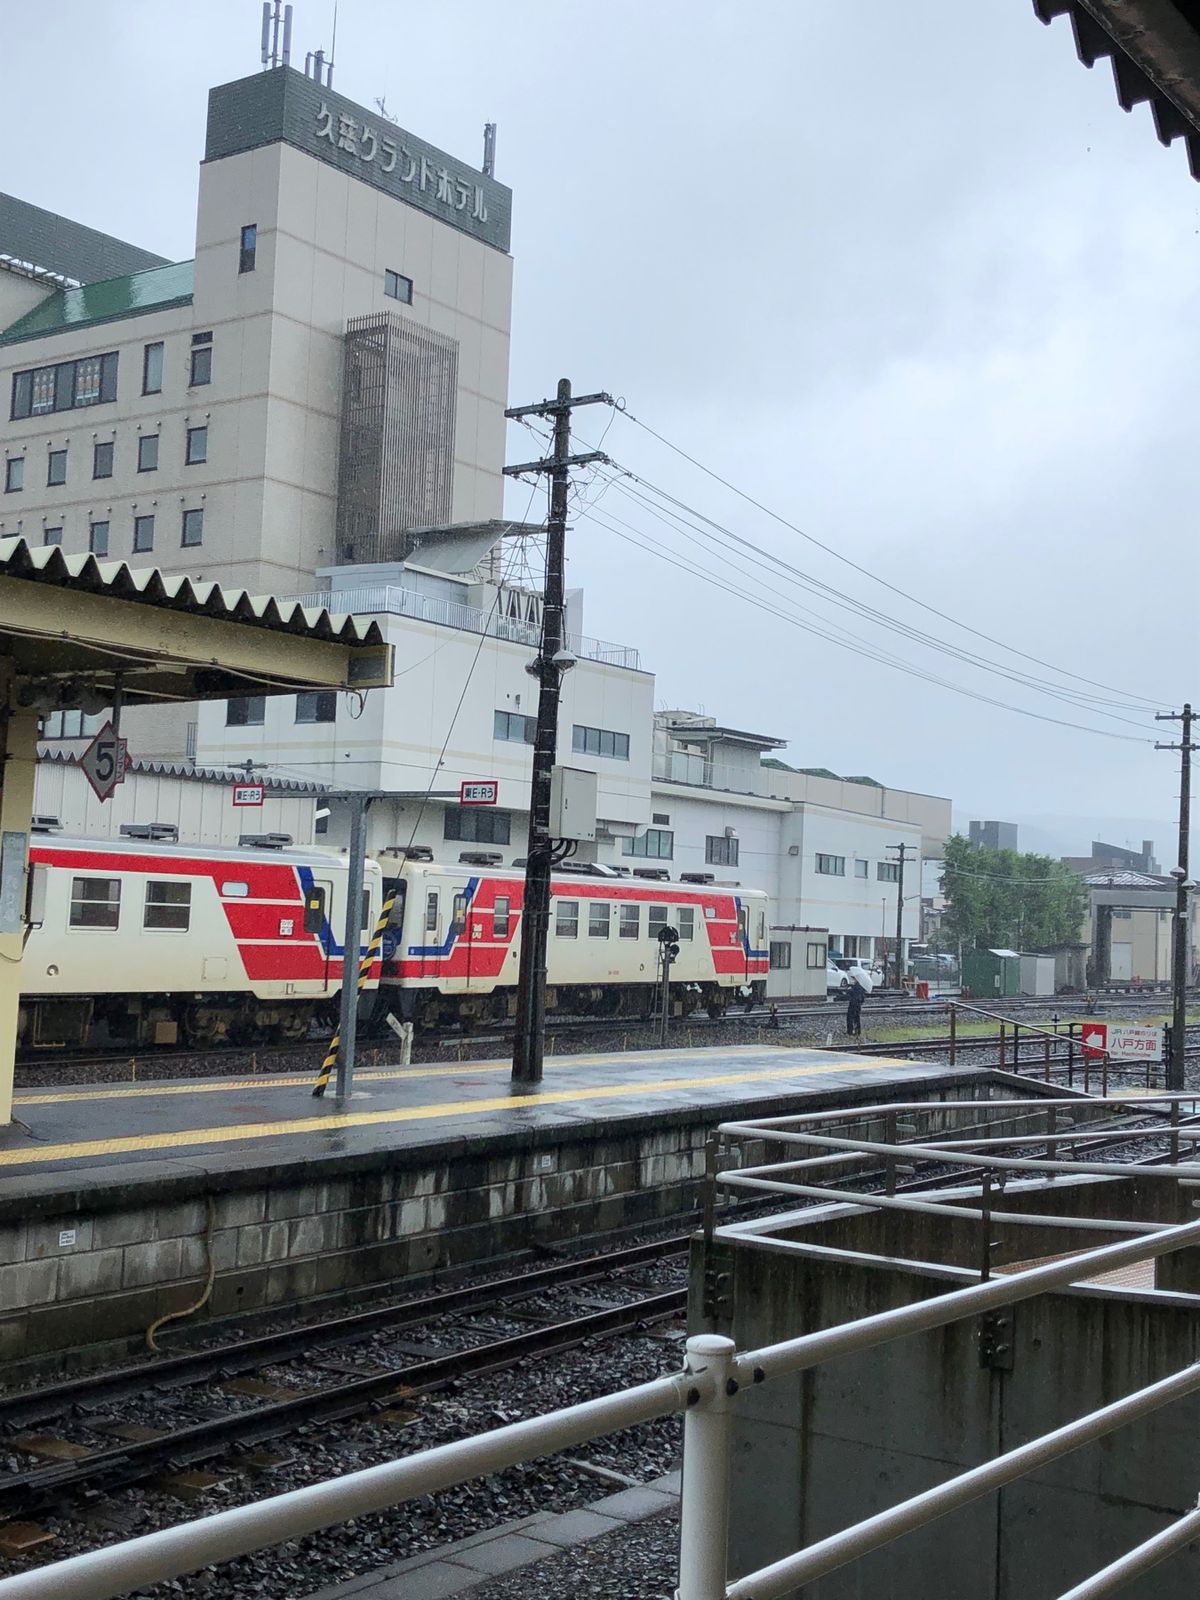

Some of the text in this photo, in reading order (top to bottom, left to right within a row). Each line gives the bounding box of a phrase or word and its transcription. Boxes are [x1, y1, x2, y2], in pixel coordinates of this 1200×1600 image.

[316, 102, 488, 223] 久慈グランドホテル
[96, 741, 116, 782] 5
[1111, 1037, 1157, 1051] 八戸方面
